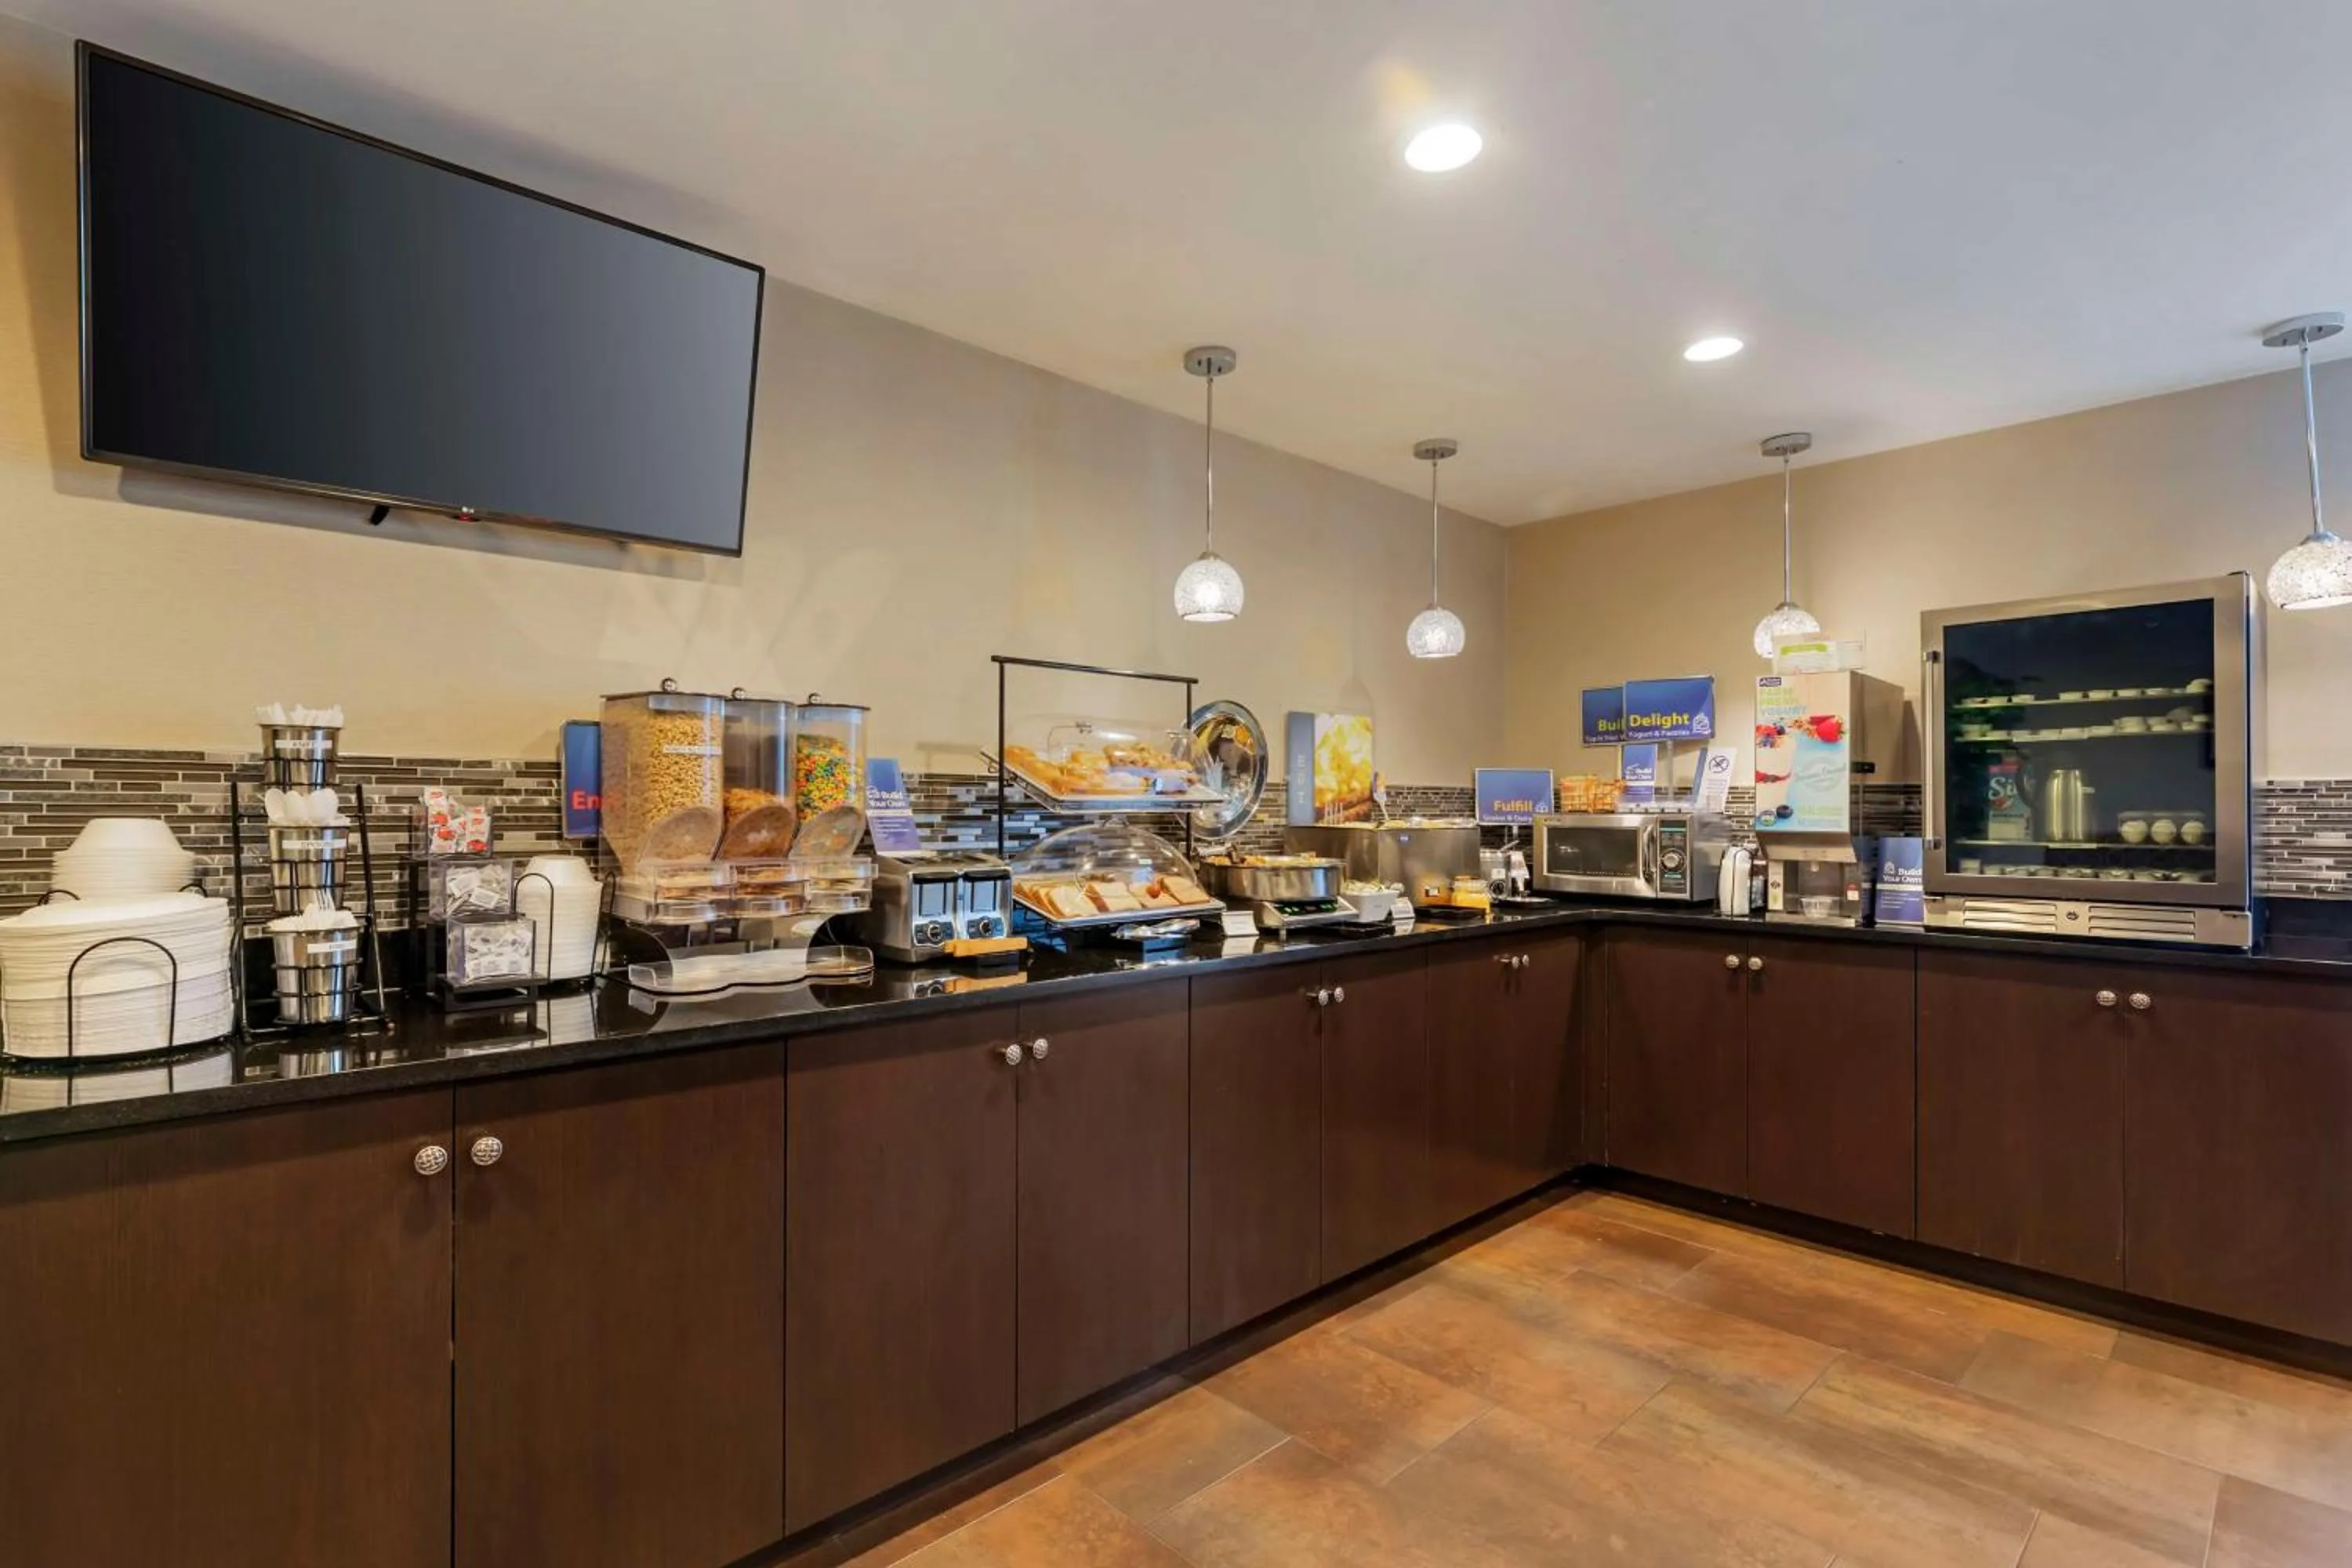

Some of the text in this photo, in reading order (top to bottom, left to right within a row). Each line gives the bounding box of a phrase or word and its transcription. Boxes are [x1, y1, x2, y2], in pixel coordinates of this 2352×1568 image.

[1629, 713, 1690, 728] Delight
[881, 790, 903, 800] Build
[1494, 799, 1534, 813] Fulfill
